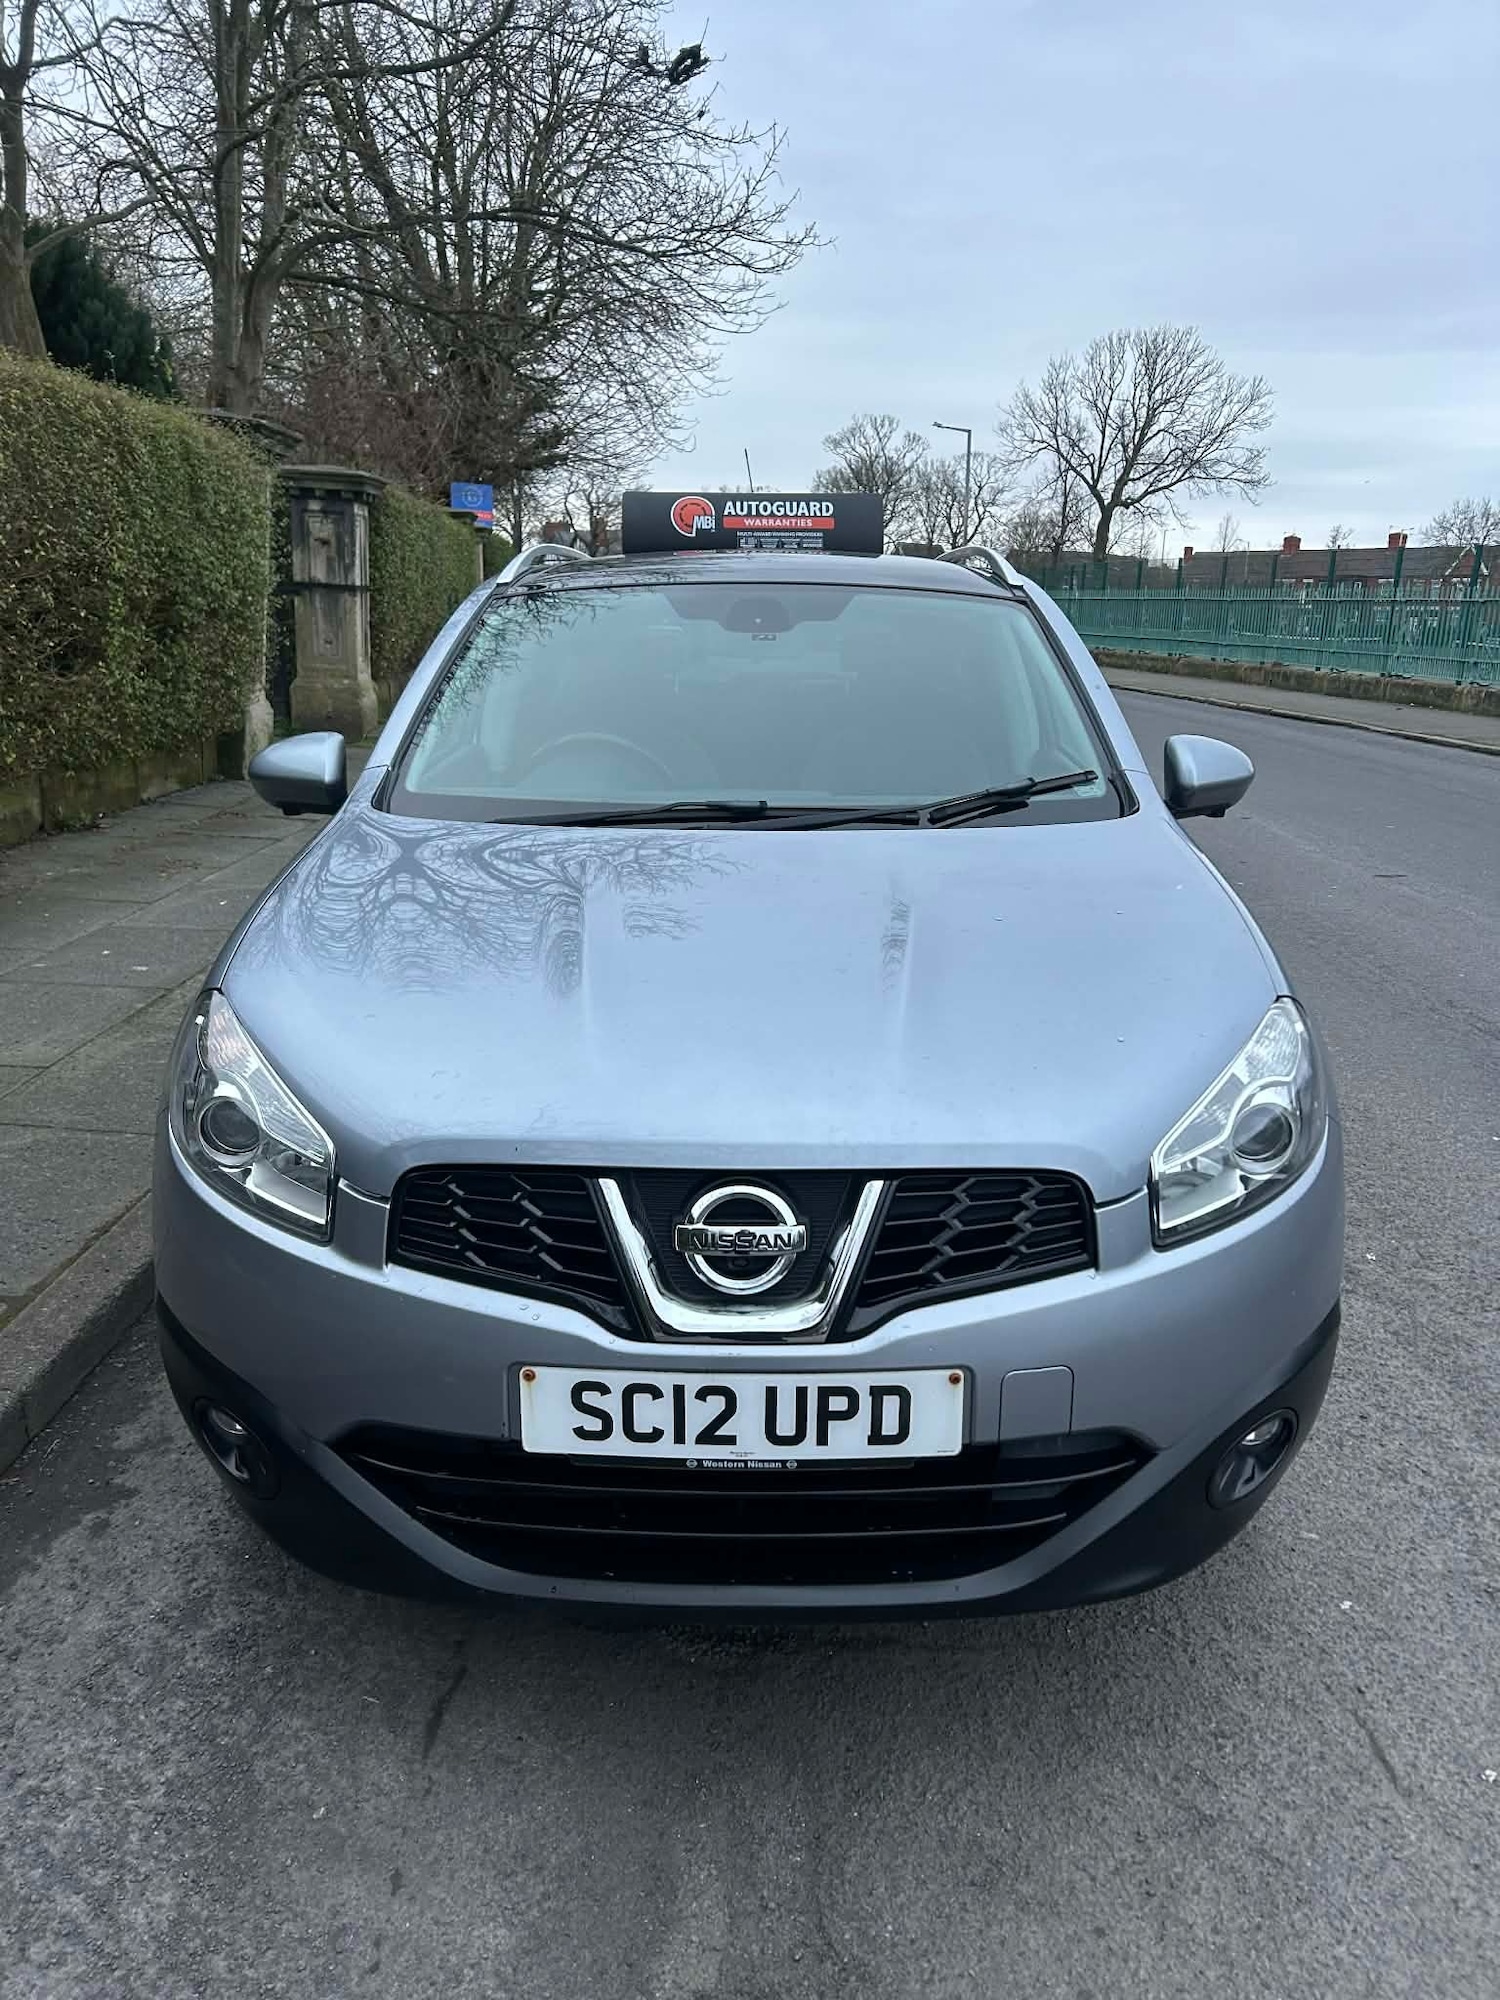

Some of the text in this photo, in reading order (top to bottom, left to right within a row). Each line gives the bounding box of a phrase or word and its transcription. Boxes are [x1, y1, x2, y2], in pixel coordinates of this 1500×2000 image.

[723, 501, 834, 517] AUTOGUARD
[694, 515, 716, 530] MBi
[743, 518, 813, 527] WARRANTIES
[689, 1230, 792, 1251] NISSAN
[570, 1380, 912, 1447] SC12 UPD
[702, 1460, 782, 1468] Western Nissan
